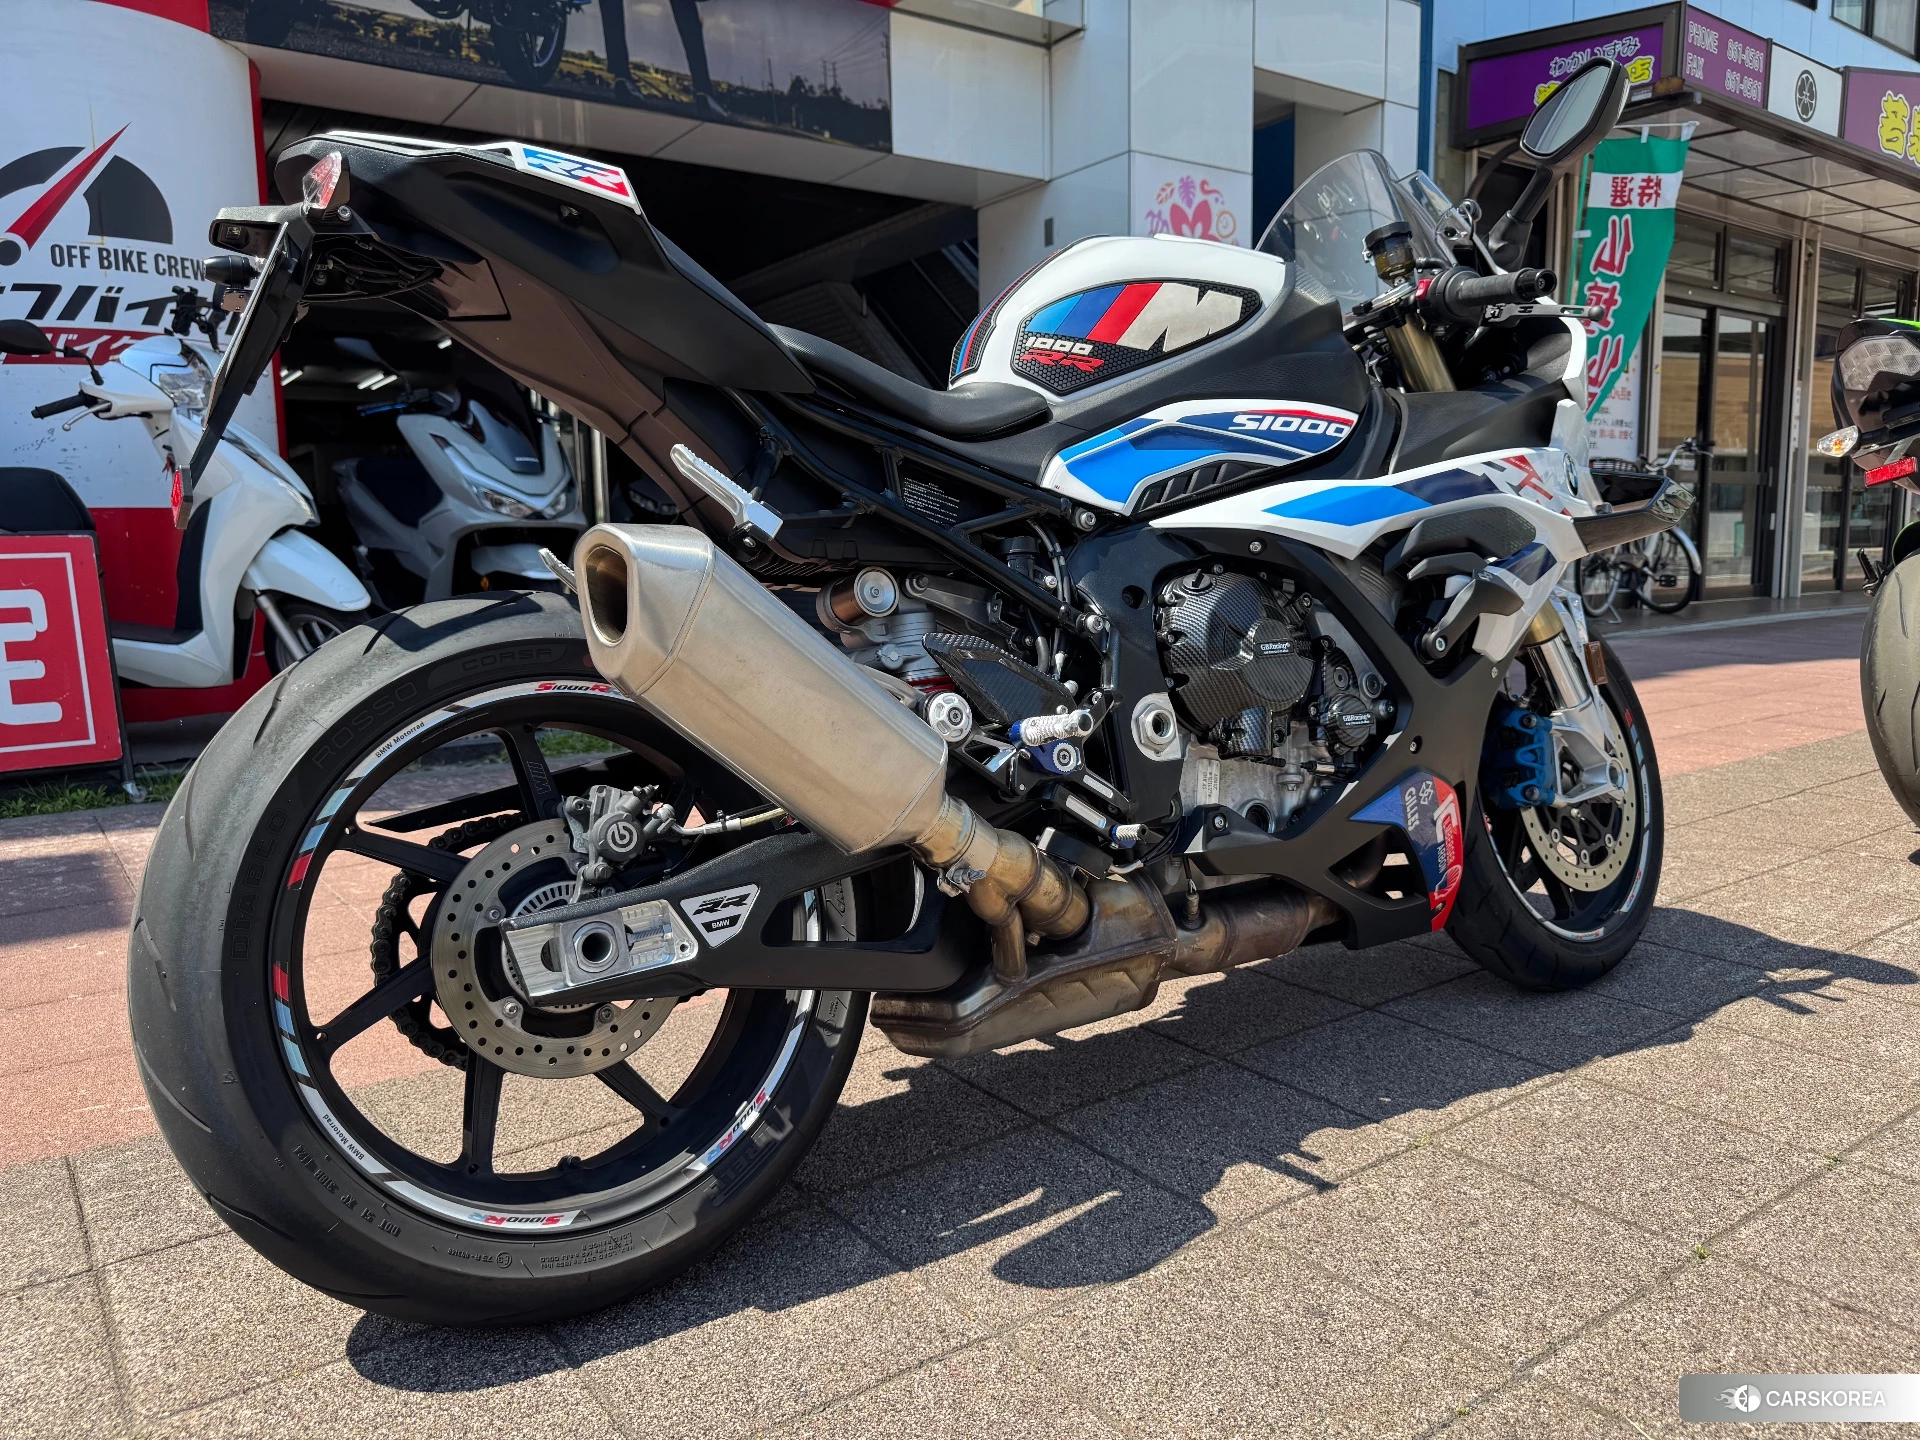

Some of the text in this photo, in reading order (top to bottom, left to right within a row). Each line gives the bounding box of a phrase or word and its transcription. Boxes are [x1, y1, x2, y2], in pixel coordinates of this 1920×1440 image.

[1688, 21, 1718, 54] PHONE
[1686, 52, 1704, 80] FAX
[50, 244, 206, 281] OFF BIKE CREW
[1019, 349, 1105, 373] RR
[1025, 336, 1093, 355] 1000
[1228, 414, 1351, 438] S1000
[461, 646, 553, 672] CORSA
[312, 682, 417, 769] ROSSO
[375, 720, 425, 758] BMW Motorrad
[1404, 786, 1420, 832] GILLES
[231, 807, 289, 961] DIABLO
[711, 918, 730, 929] BMW
[322, 1113, 365, 1161] BMW Motorrad
